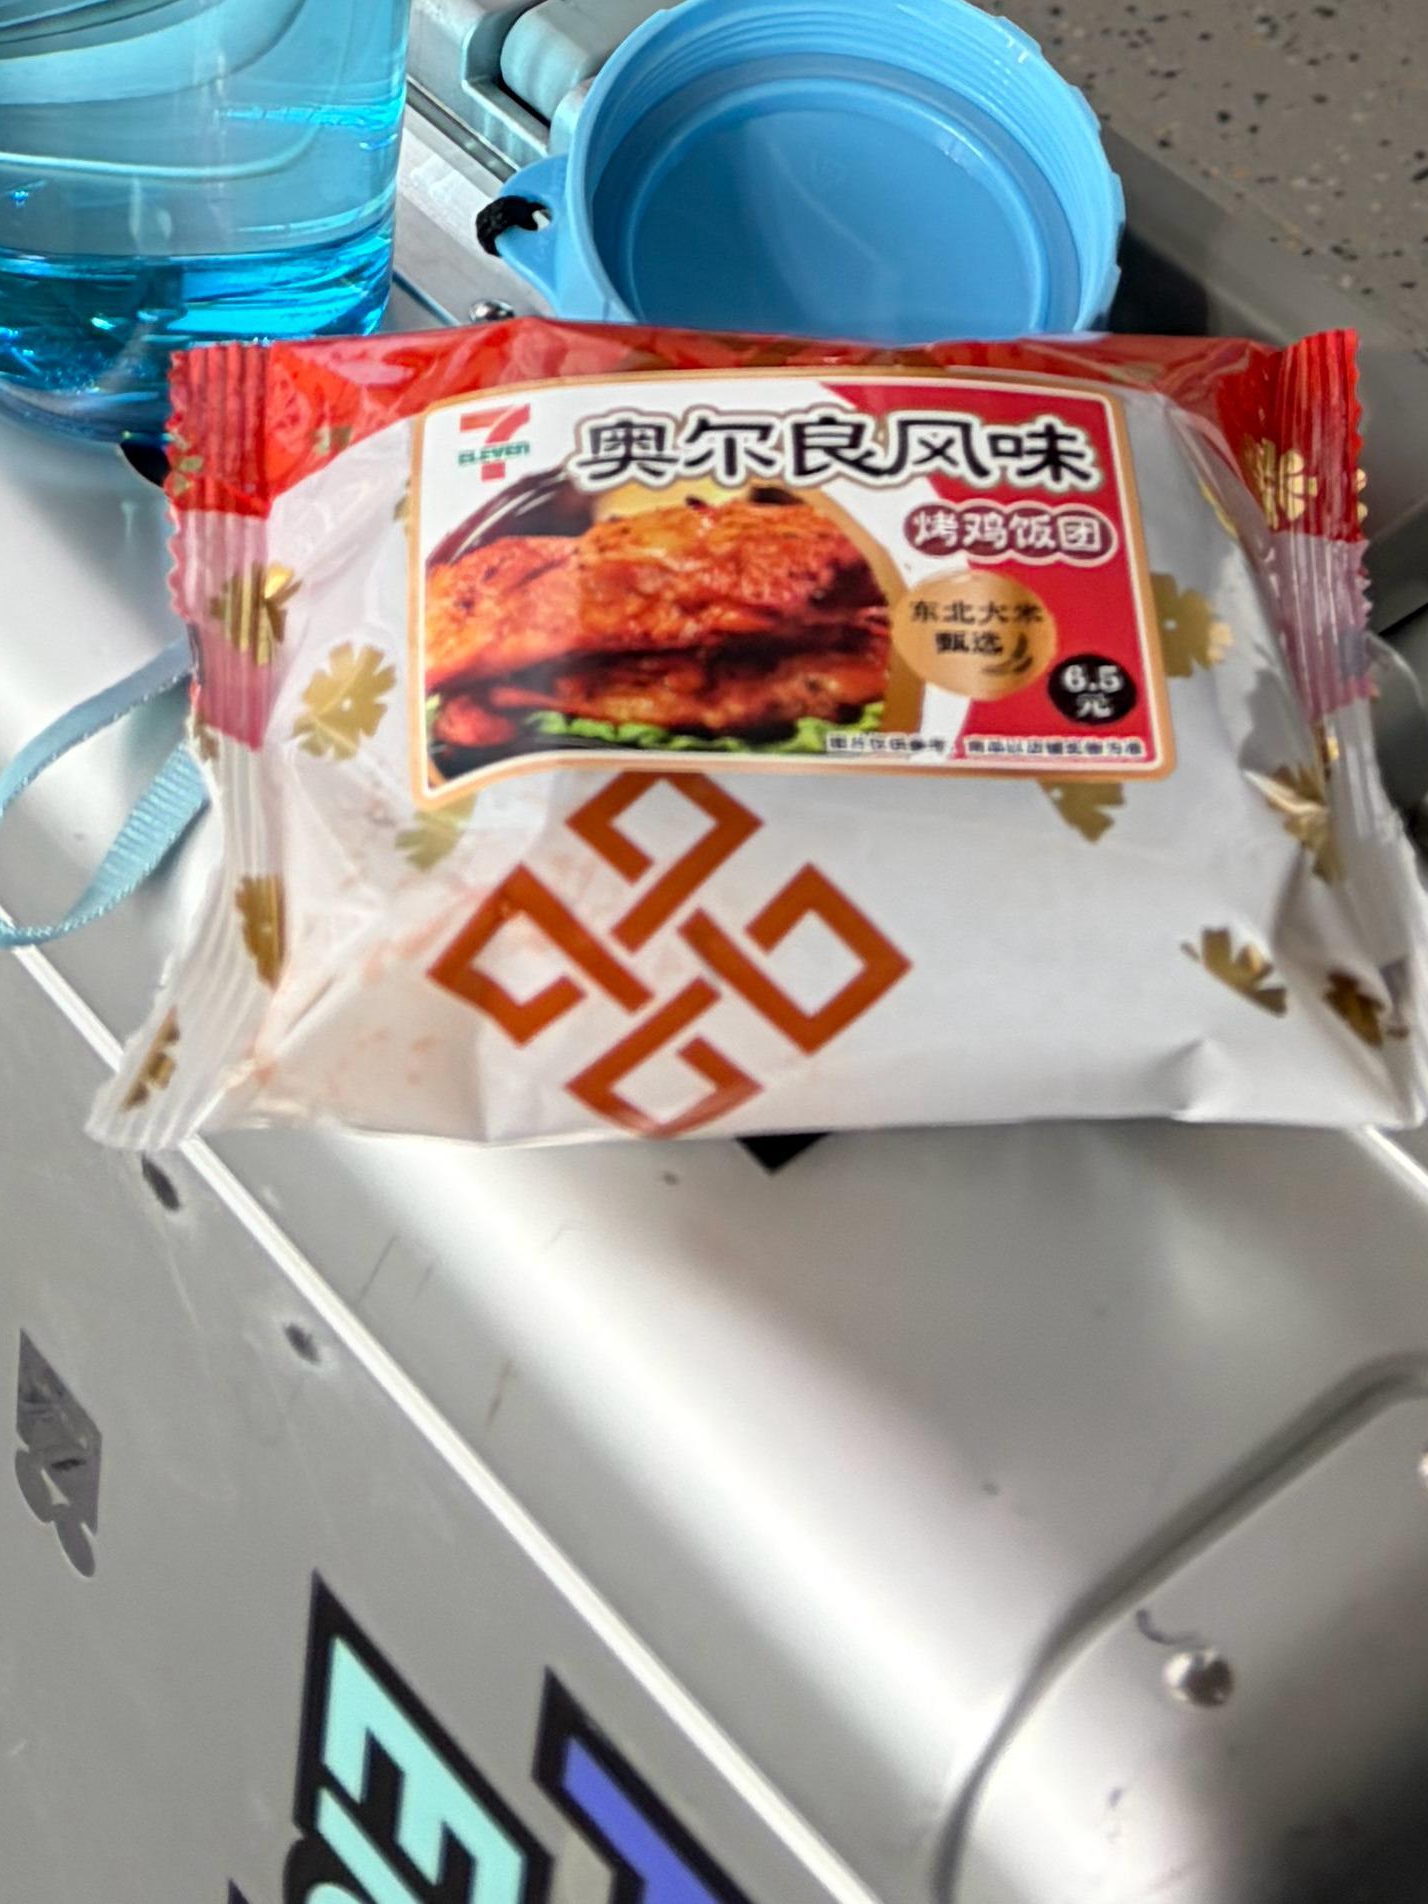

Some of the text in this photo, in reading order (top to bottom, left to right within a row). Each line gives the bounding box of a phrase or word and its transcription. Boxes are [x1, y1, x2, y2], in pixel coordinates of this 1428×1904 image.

[459, 403, 531, 482] 7
[575, 414, 1100, 485] 奥尔良风味
[912, 512, 1103, 553] 烤鸡饭团
[909, 600, 1042, 625] 东北大米
[935, 630, 1003, 655] 甄选
[1062, 665, 1124, 693] 6.5
[1076, 694, 1114, 718] 元
